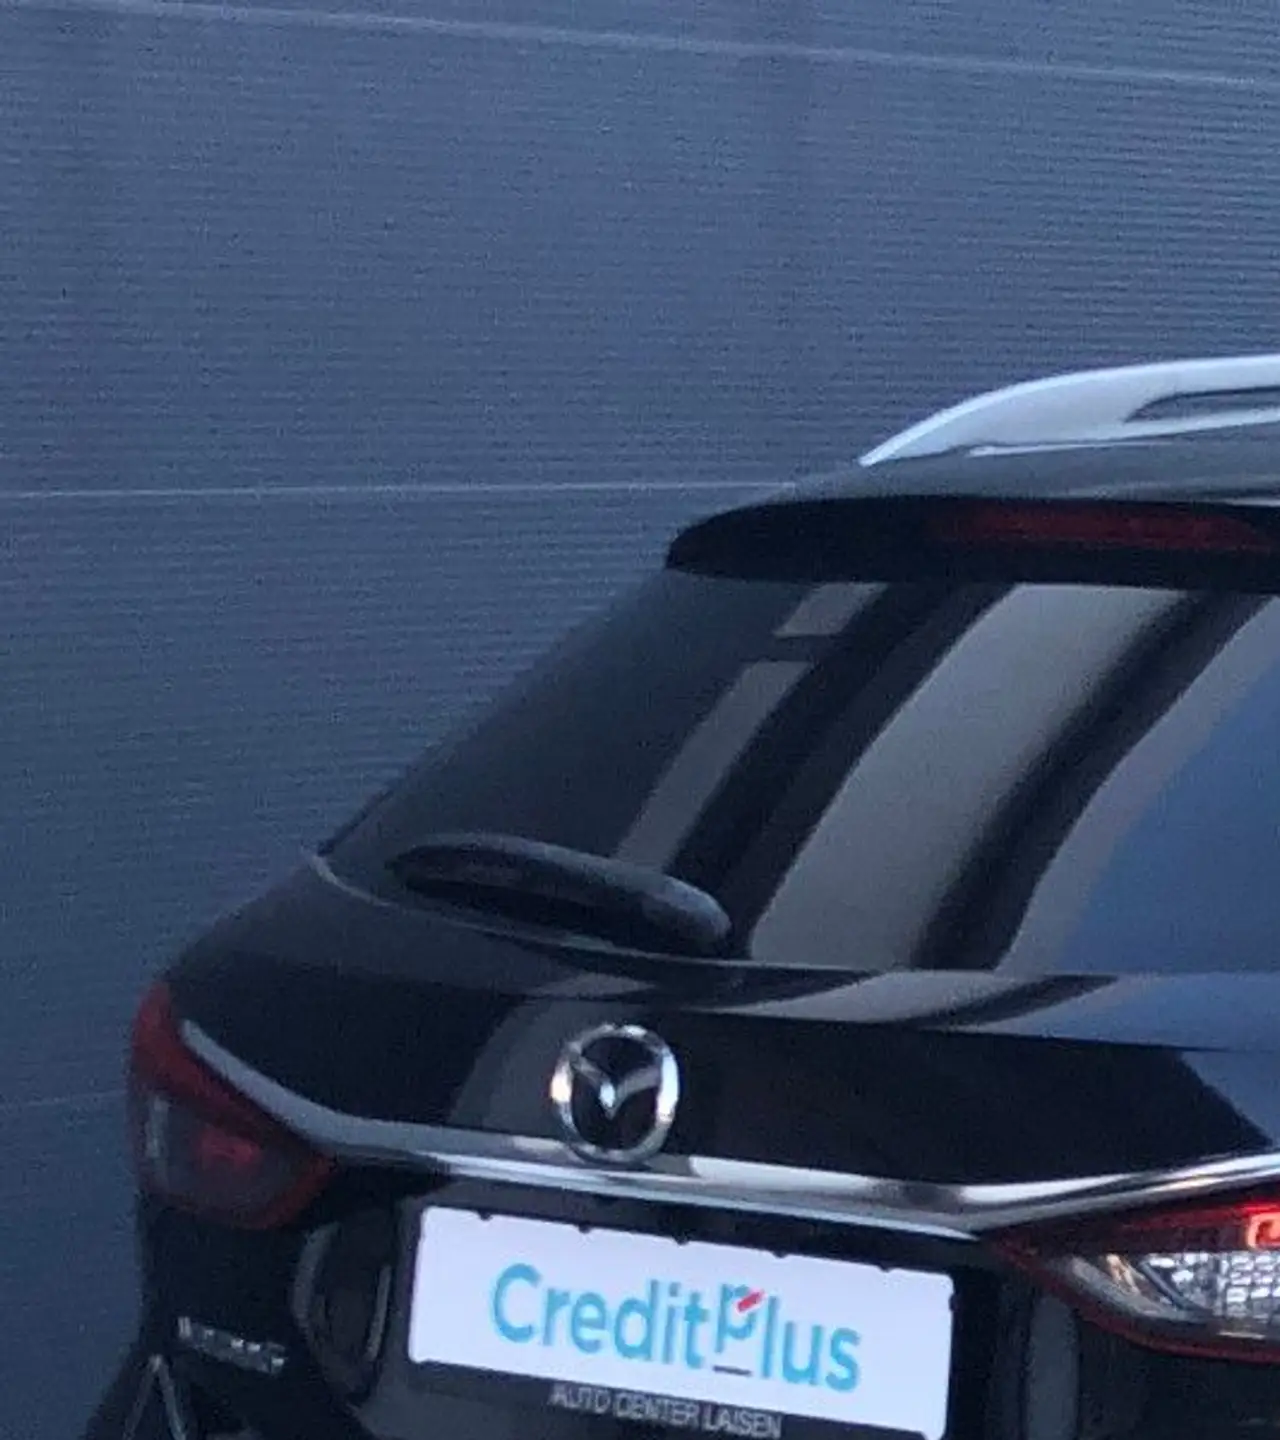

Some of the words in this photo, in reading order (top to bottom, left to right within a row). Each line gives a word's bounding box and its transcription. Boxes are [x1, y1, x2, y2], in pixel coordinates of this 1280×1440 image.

[493, 1263, 861, 1391] CreditPlus
[551, 1384, 611, 1413] AUTO
[614, 1392, 699, 1427] CENTER
